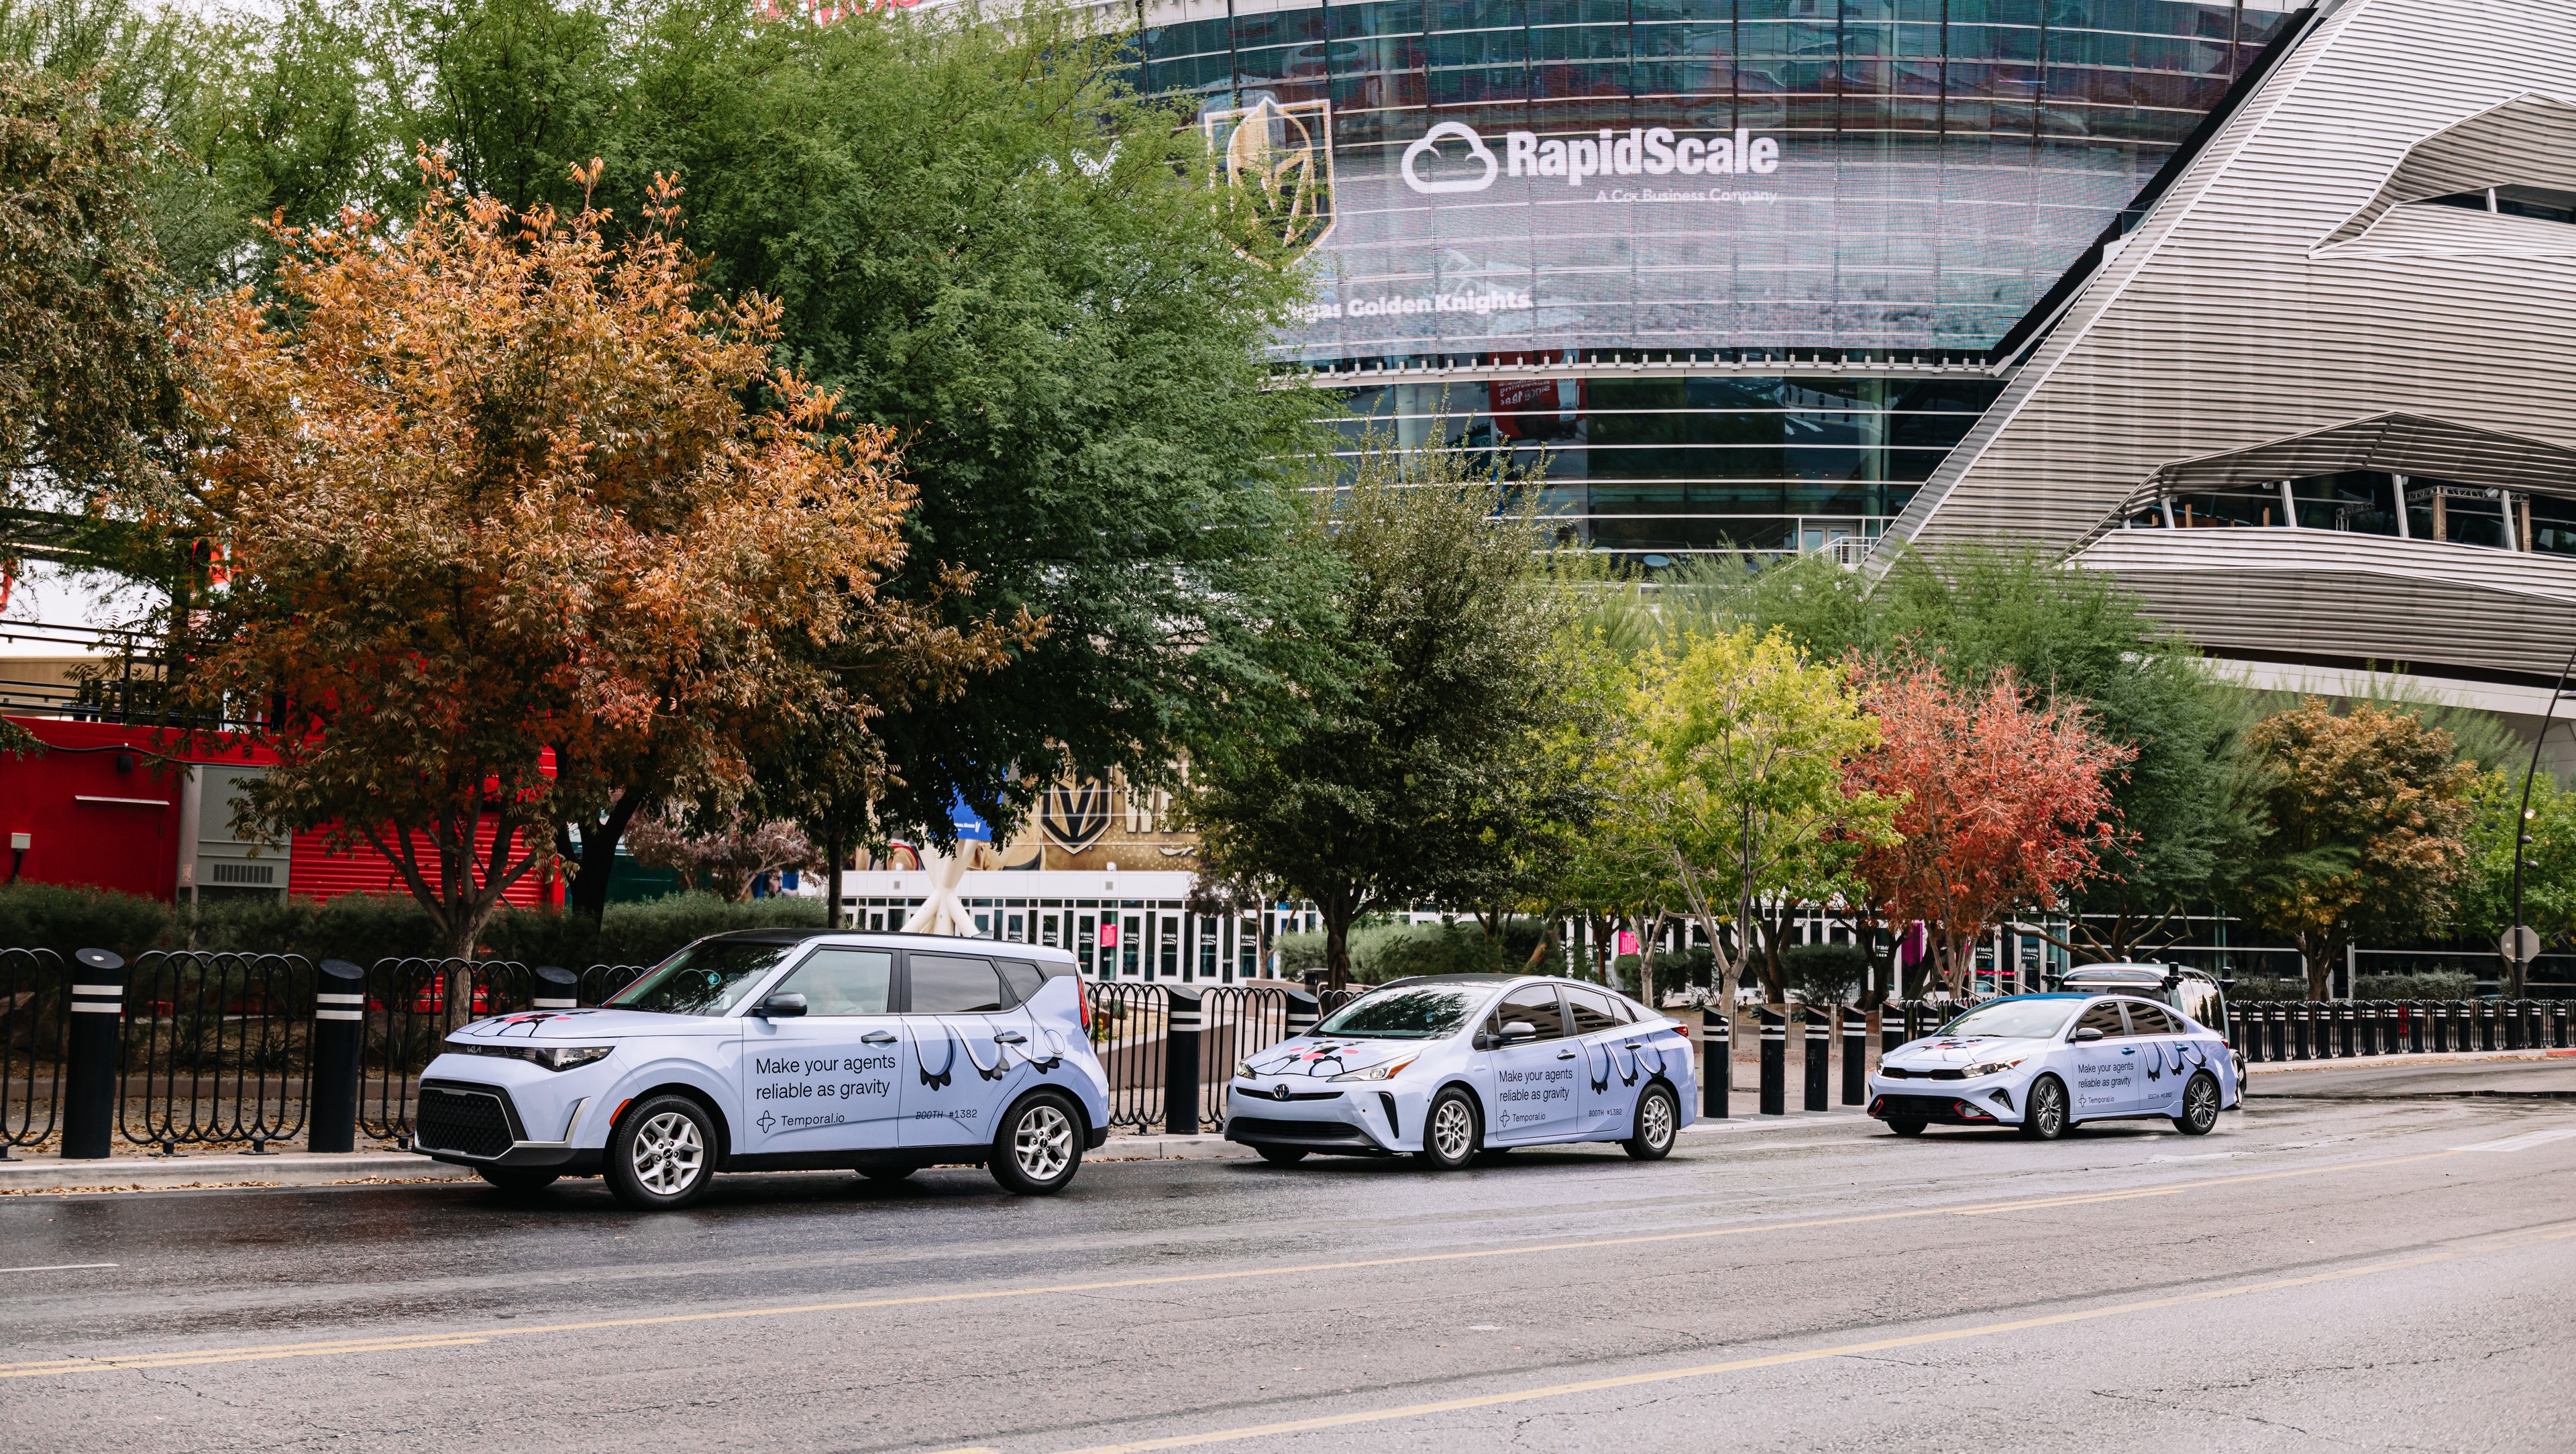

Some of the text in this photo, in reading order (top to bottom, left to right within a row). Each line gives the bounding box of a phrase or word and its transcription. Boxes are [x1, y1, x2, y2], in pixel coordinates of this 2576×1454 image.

[1507, 127, 1779, 186] RapidScale
[1596, 190, 1609, 201] A
[1643, 189, 1705, 201] Business
[1709, 188, 1778, 204] Company
[1347, 295, 1433, 317] Golden
[1436, 291, 1532, 315] Knights
[756, 1054, 896, 1076] Make your agents
[2078, 1062, 2134, 1075] Make your agents
[1499, 1068, 1573, 1084] Make your agents
[2078, 1078, 2101, 1088] reliable
[2111, 1076, 2132, 1088] gravity
[757, 1078, 890, 1100] reliable as gravity
[1500, 1087, 1570, 1102] reliable as gravity
[2088, 1096, 2115, 1104] Temporal.io
[781, 1113, 845, 1127] Temporal.io
[916, 1109, 977, 1120] BOOTH #1382
[1513, 1112, 1546, 1123] Temporal.io
